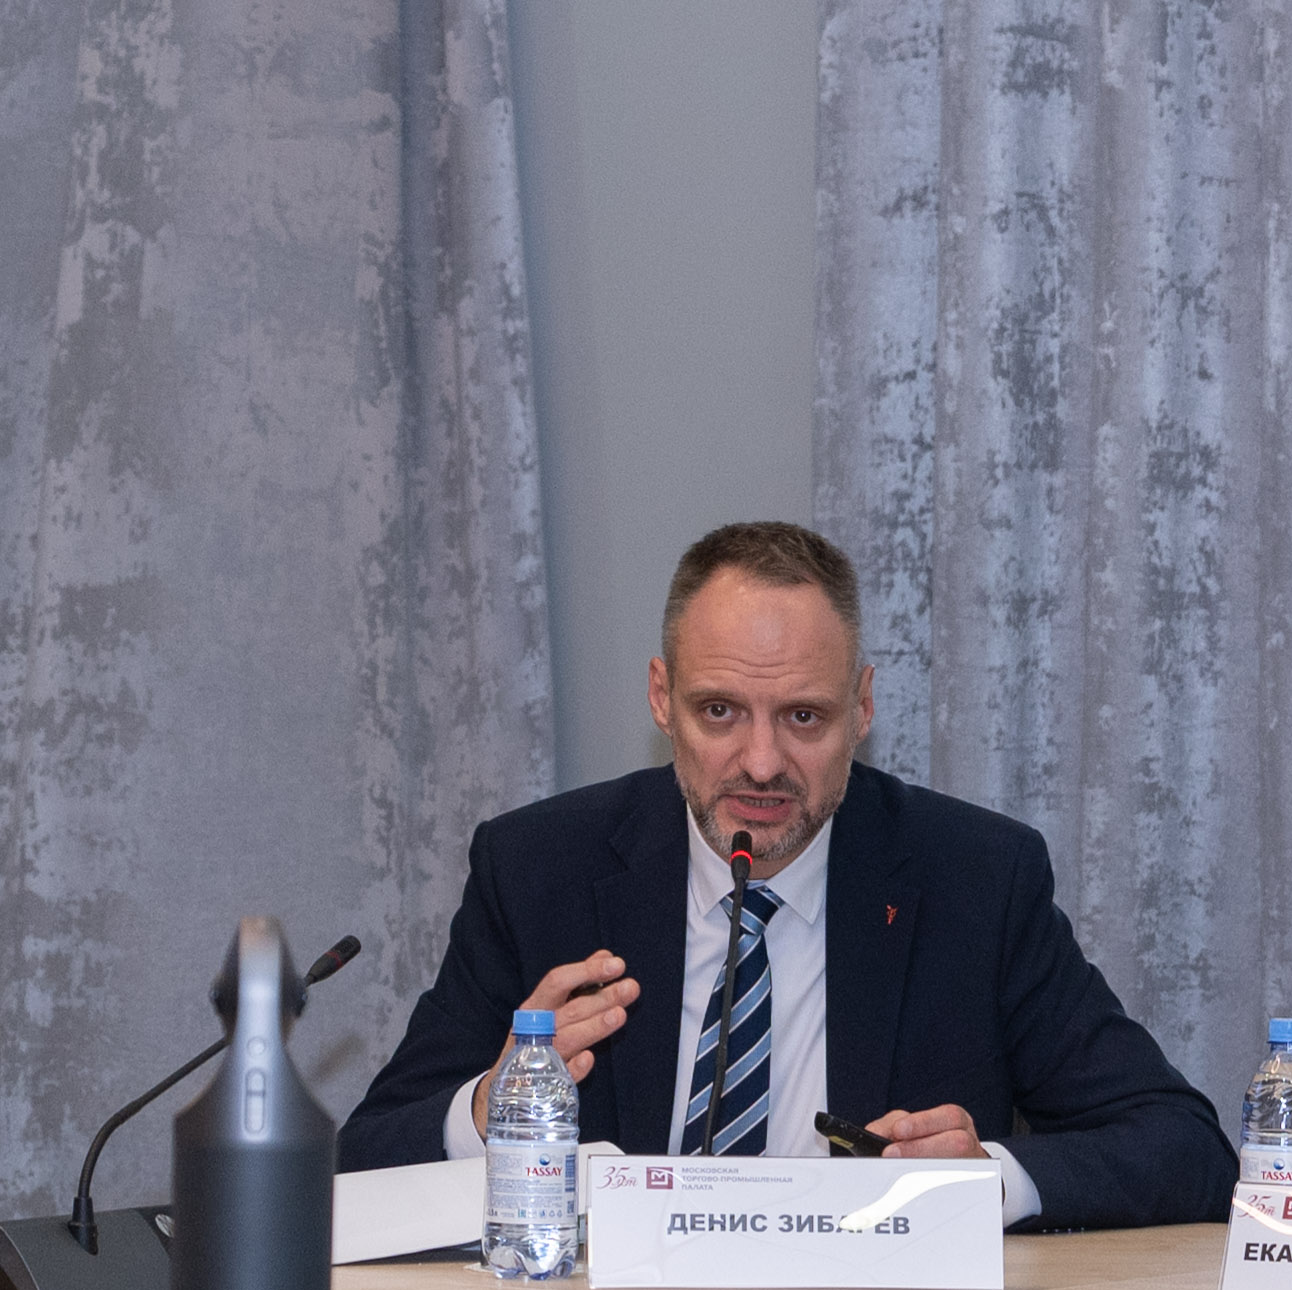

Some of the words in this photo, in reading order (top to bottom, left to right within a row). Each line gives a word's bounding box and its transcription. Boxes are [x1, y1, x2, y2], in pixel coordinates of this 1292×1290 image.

[525, 1167, 563, 1177] TASSAY
[681, 1167, 739, 1175] МОСКОВСКАЯ
[667, 1213, 768, 1235] ДЕНИС
[778, 1213, 911, 1235] ЗИБЕВ
